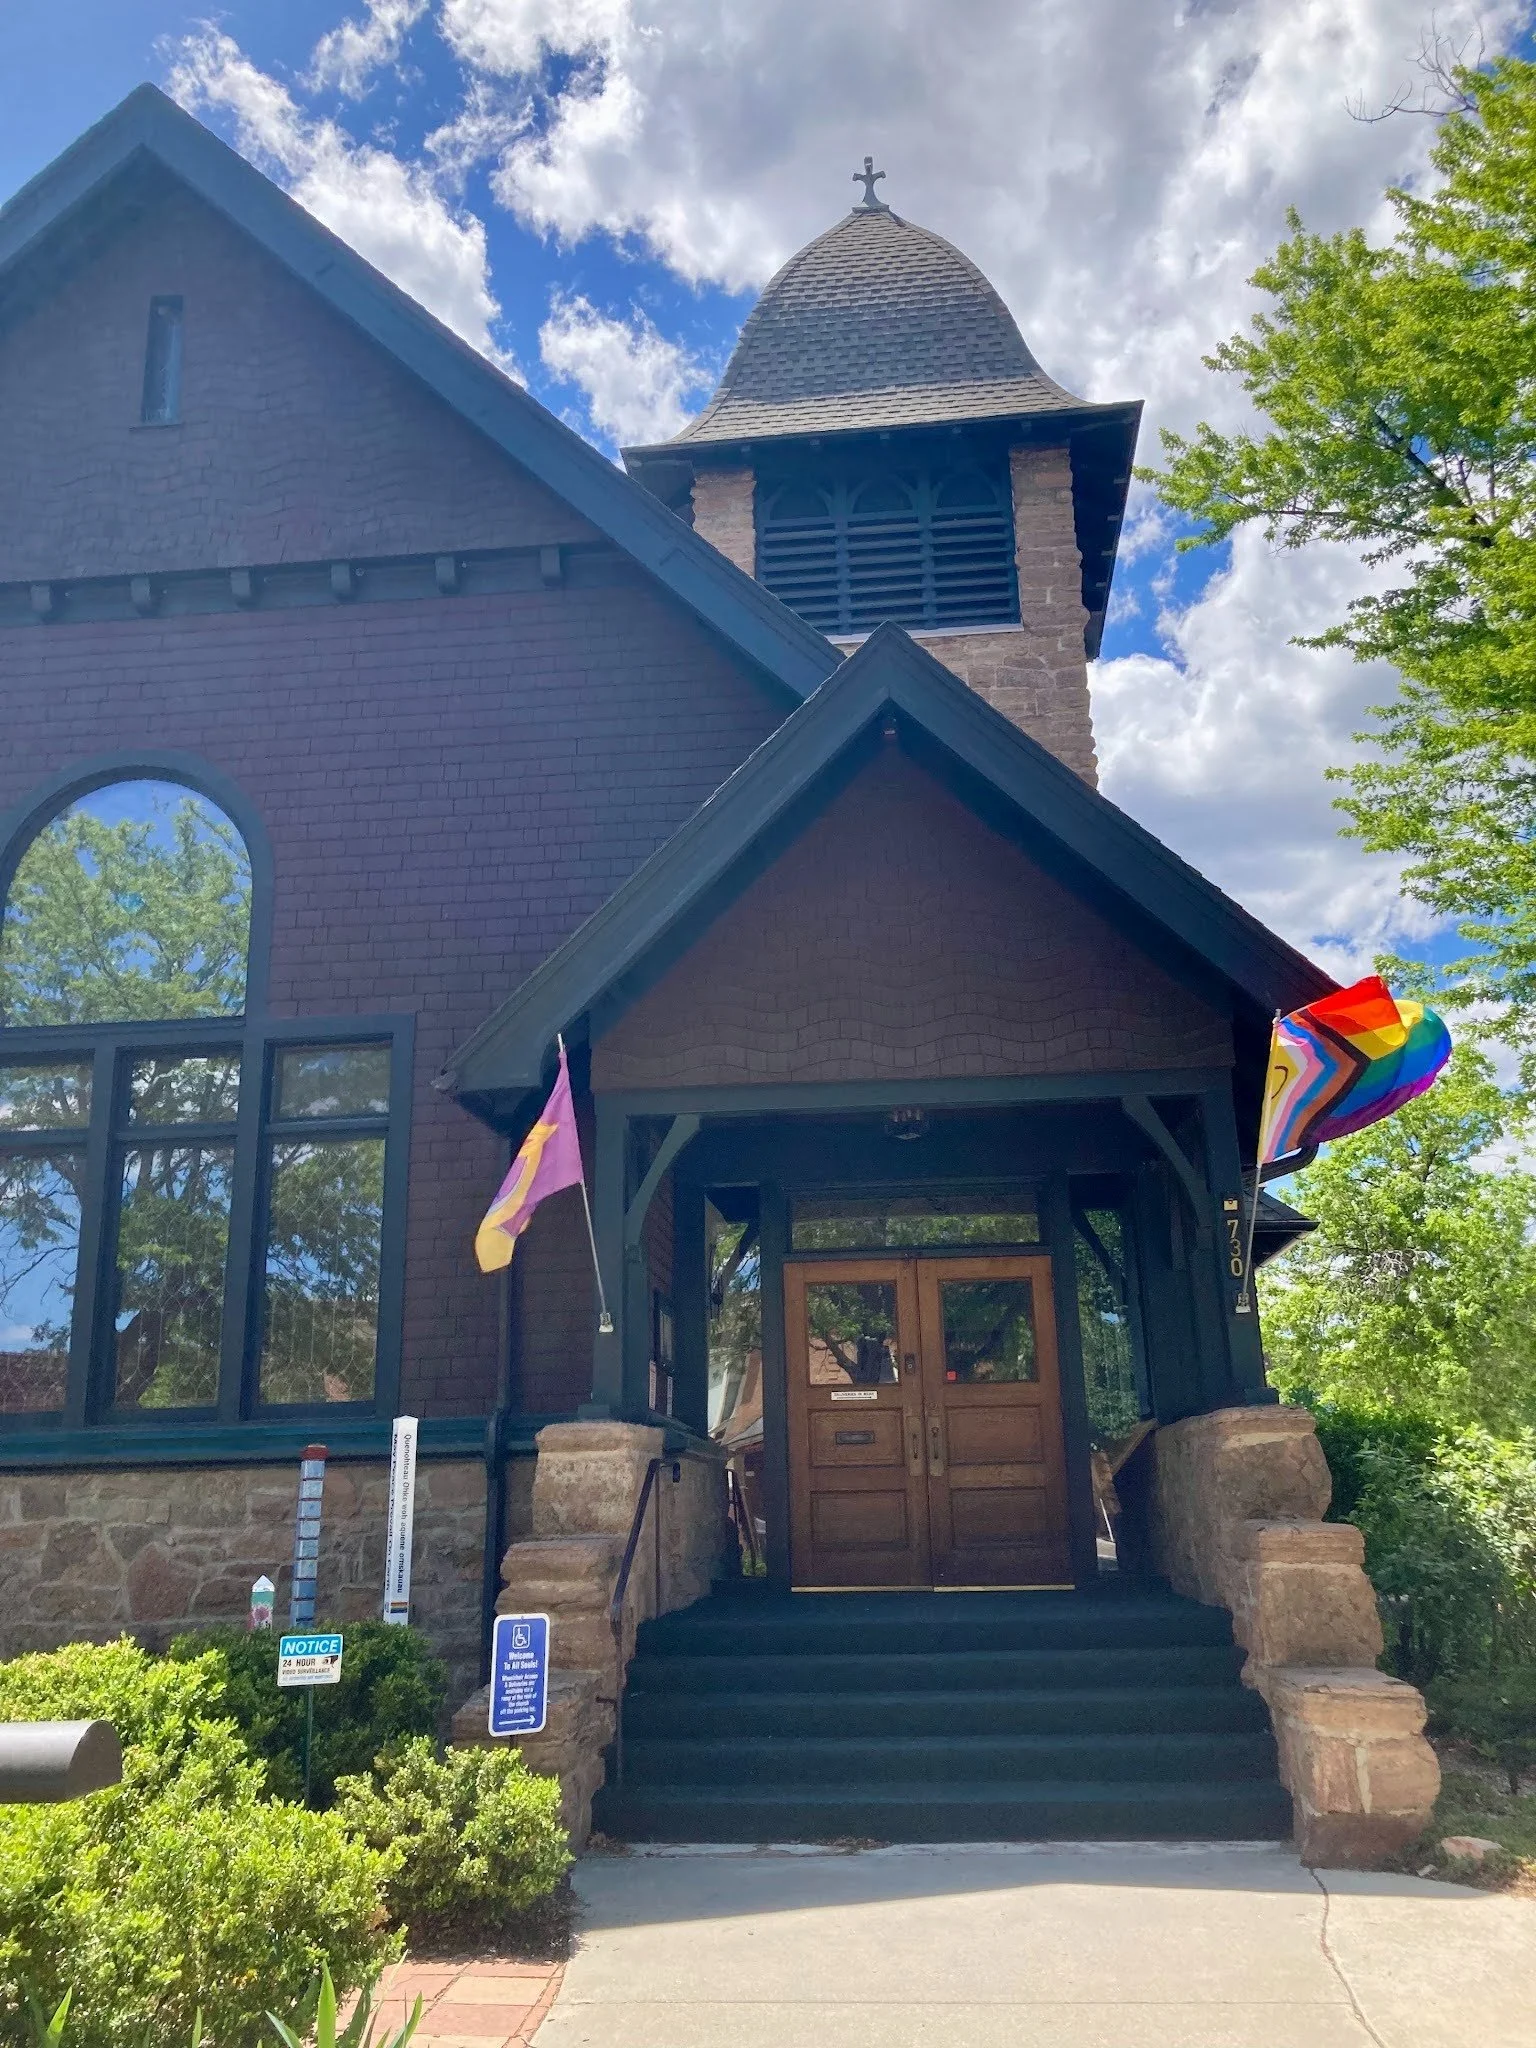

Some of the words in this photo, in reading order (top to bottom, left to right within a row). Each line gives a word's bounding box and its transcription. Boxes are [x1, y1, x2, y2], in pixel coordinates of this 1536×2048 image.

[1227, 1219, 1243, 1277] 730
[283, 1639, 339, 1655] NOTICE
[508, 1652, 535, 1660] Welcome
[282, 1659, 292, 1667] 24
[296, 1658, 316, 1667] HOUR
[503, 1662, 511, 1670] To
[511, 1661, 520, 1670] All
[520, 1660, 538, 1669] Souls!
[297, 1667, 330, 1675] SURVEILLANCE
